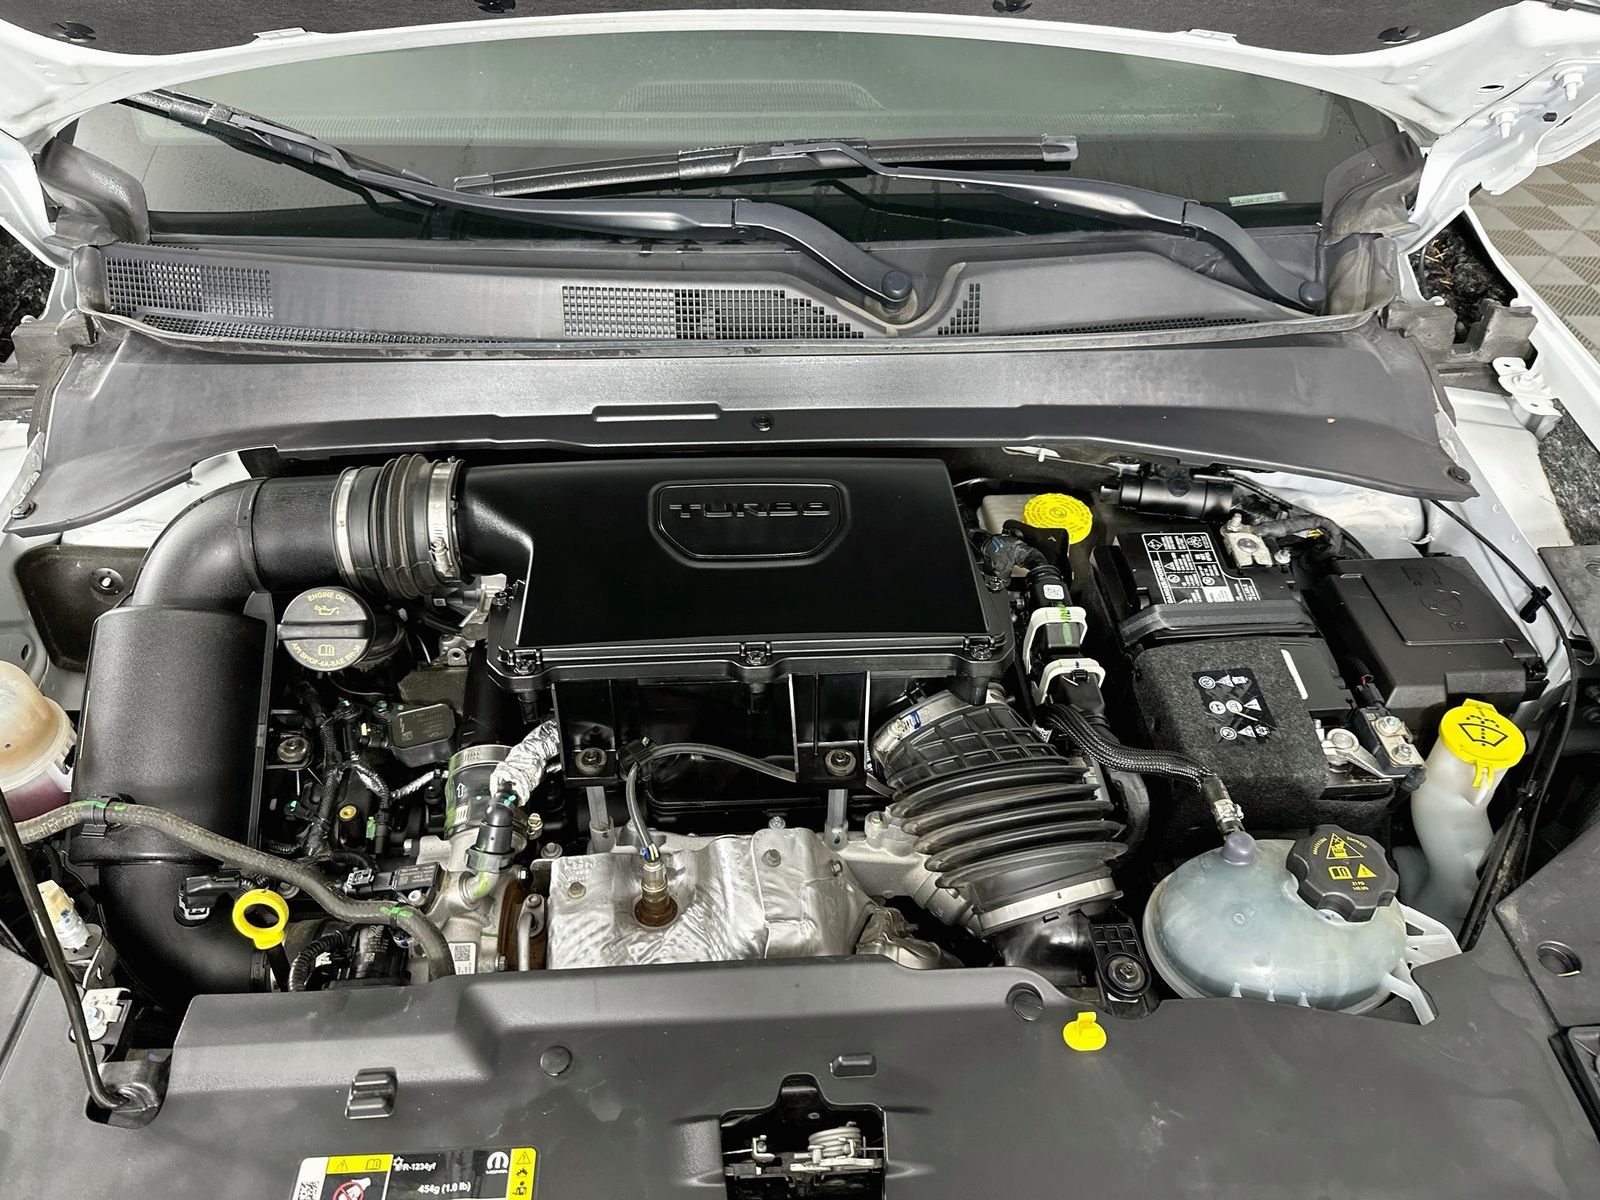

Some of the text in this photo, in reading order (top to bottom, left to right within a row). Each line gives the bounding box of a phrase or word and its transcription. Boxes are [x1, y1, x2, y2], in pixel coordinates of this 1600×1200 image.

[307, 591, 346, 603] ENGINE OIL
[402, 1162, 437, 1172] R-1234yf
[417, 1181, 472, 1195] 454g (1.0 lb)
